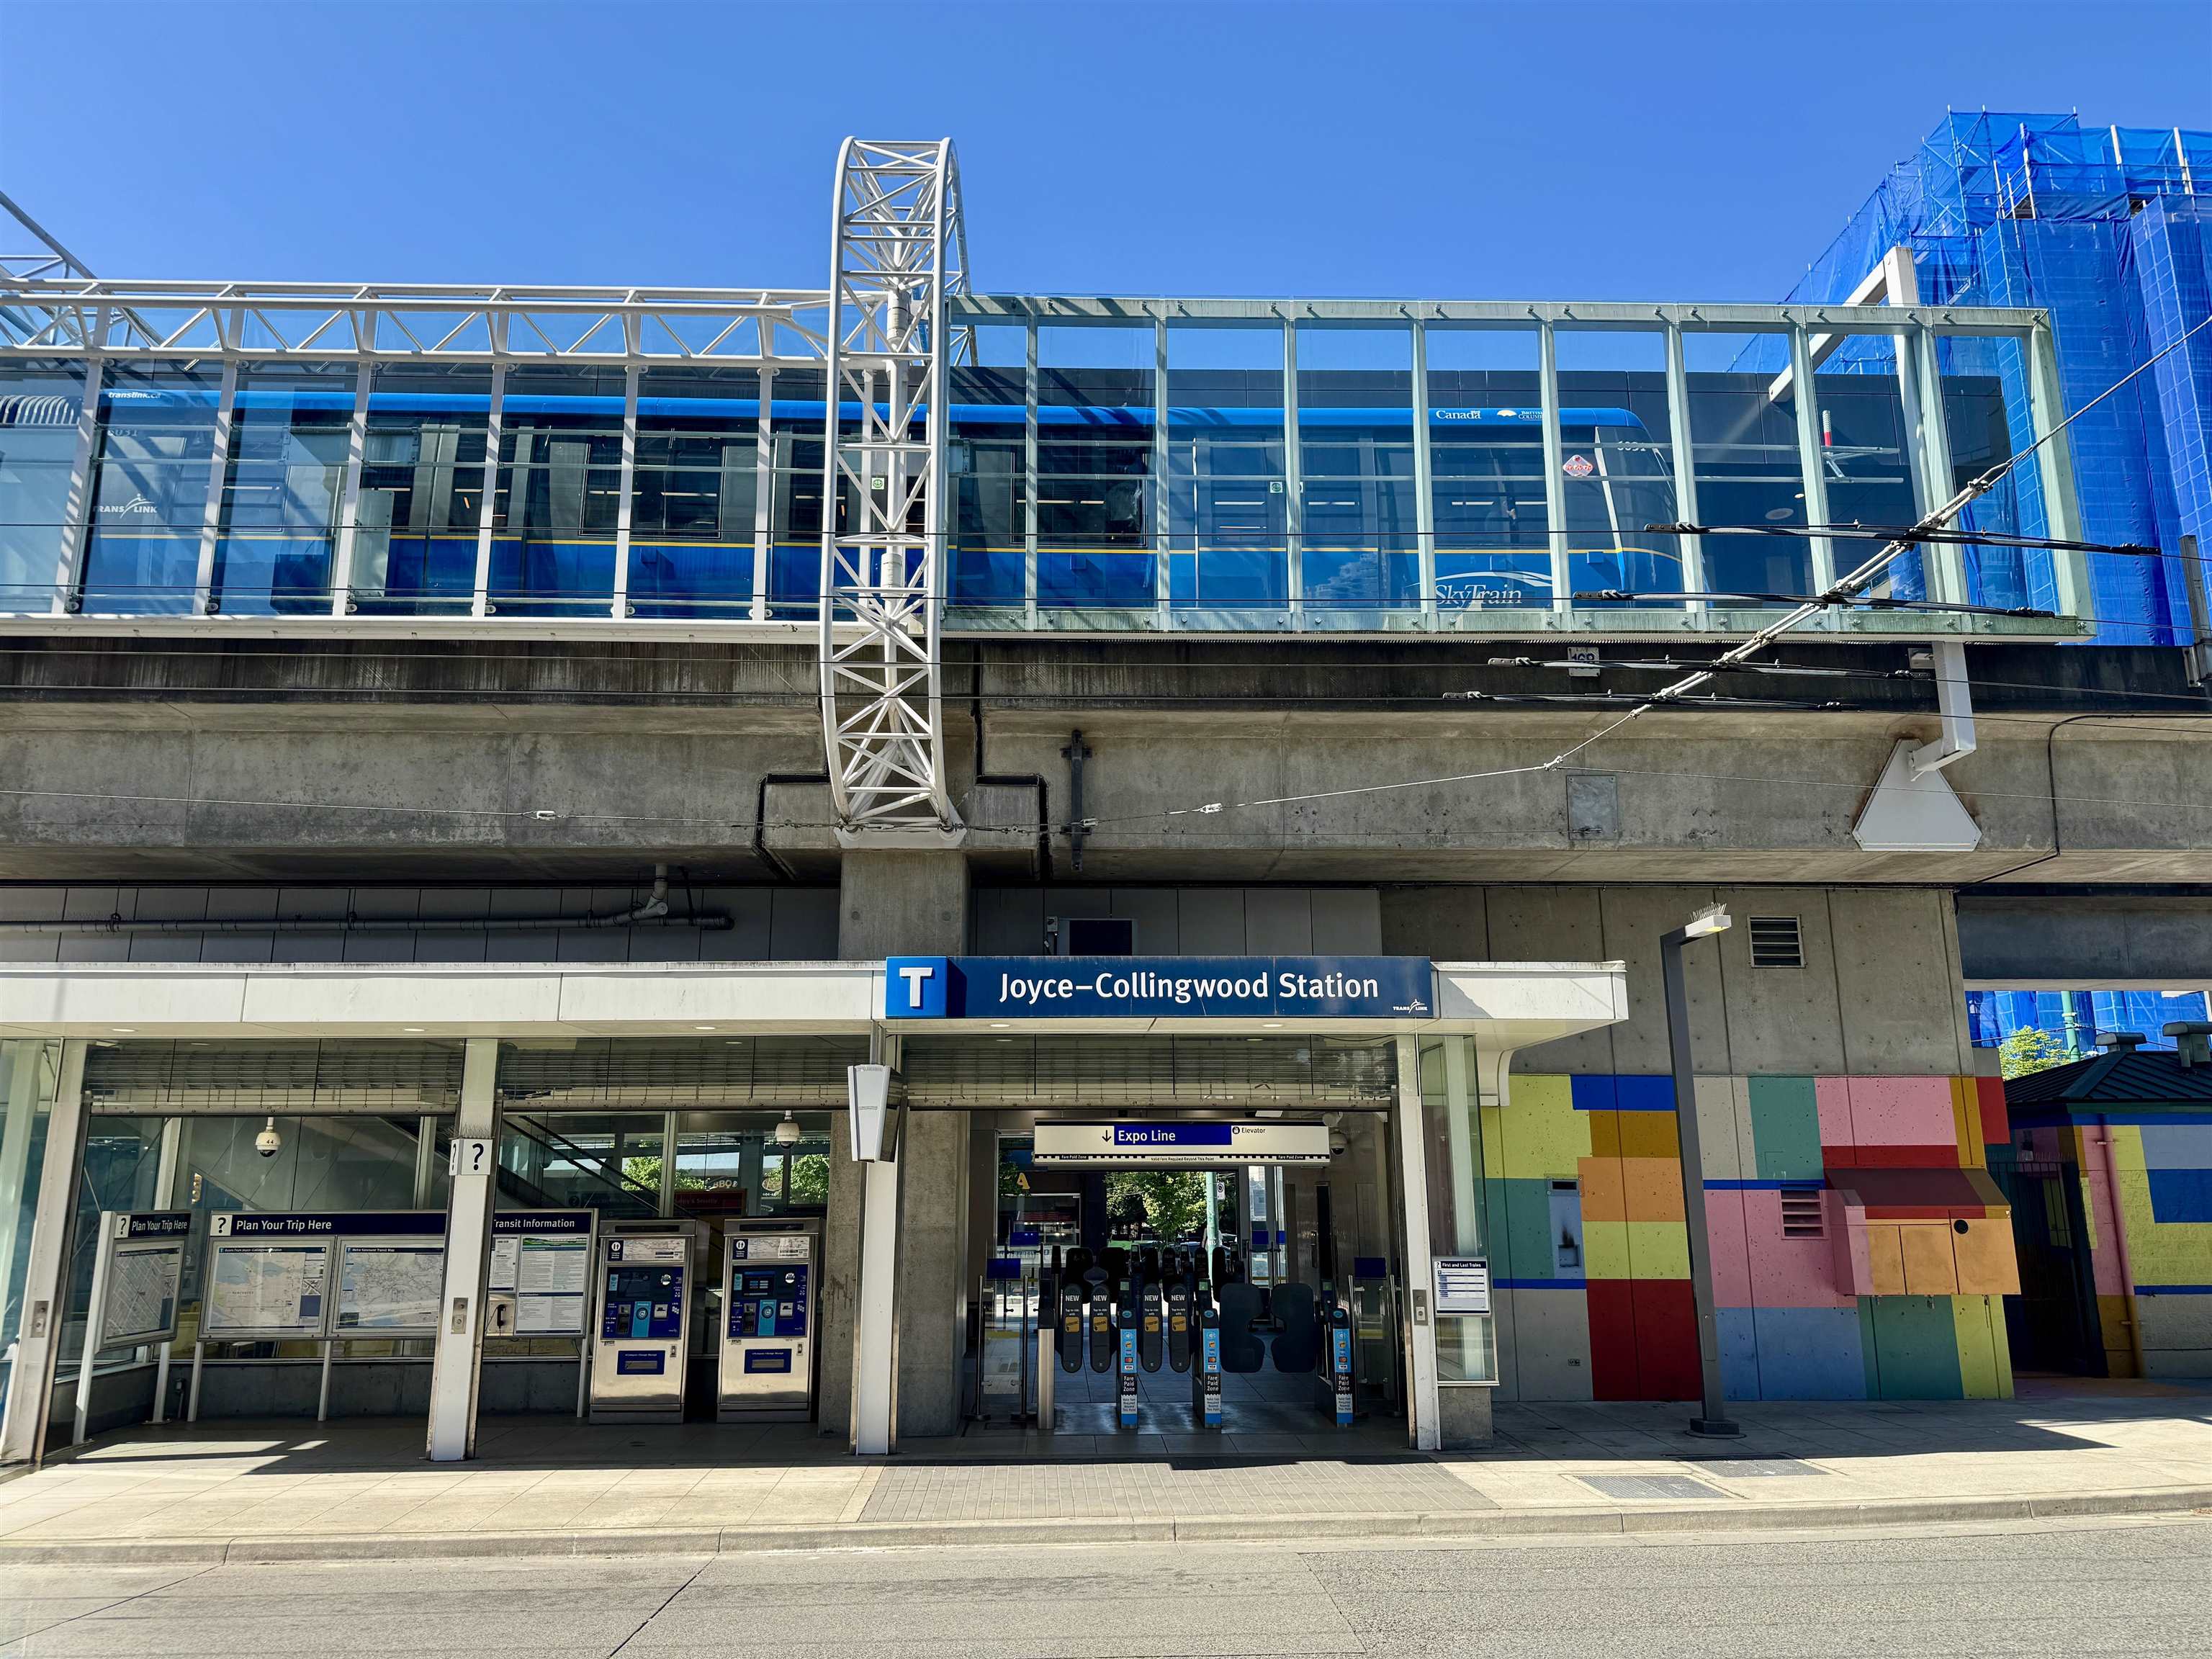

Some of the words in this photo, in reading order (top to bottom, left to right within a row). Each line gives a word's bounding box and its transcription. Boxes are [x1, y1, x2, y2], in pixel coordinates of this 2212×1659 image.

[1436, 410, 1481, 419] Canada
[1434, 585, 1522, 608] SkyTrain
[899, 967, 934, 1007] T
[1279, 972, 1378, 998] Station
[1118, 1130, 1148, 1143] Expo
[1151, 1130, 1176, 1141] Line
[132, 1220, 145, 1231] Plan
[147, 1220, 161, 1231] Your
[161, 1220, 173, 1232] Trip
[174, 1220, 188, 1229] Here
[236, 1220, 258, 1230] Plan
[261, 1220, 284, 1230] Your
[286, 1220, 305, 1232] Trip
[308, 1220, 332, 1230] Here
[493, 1218, 521, 1228] ransit
[523, 1218, 575, 1228] Information
